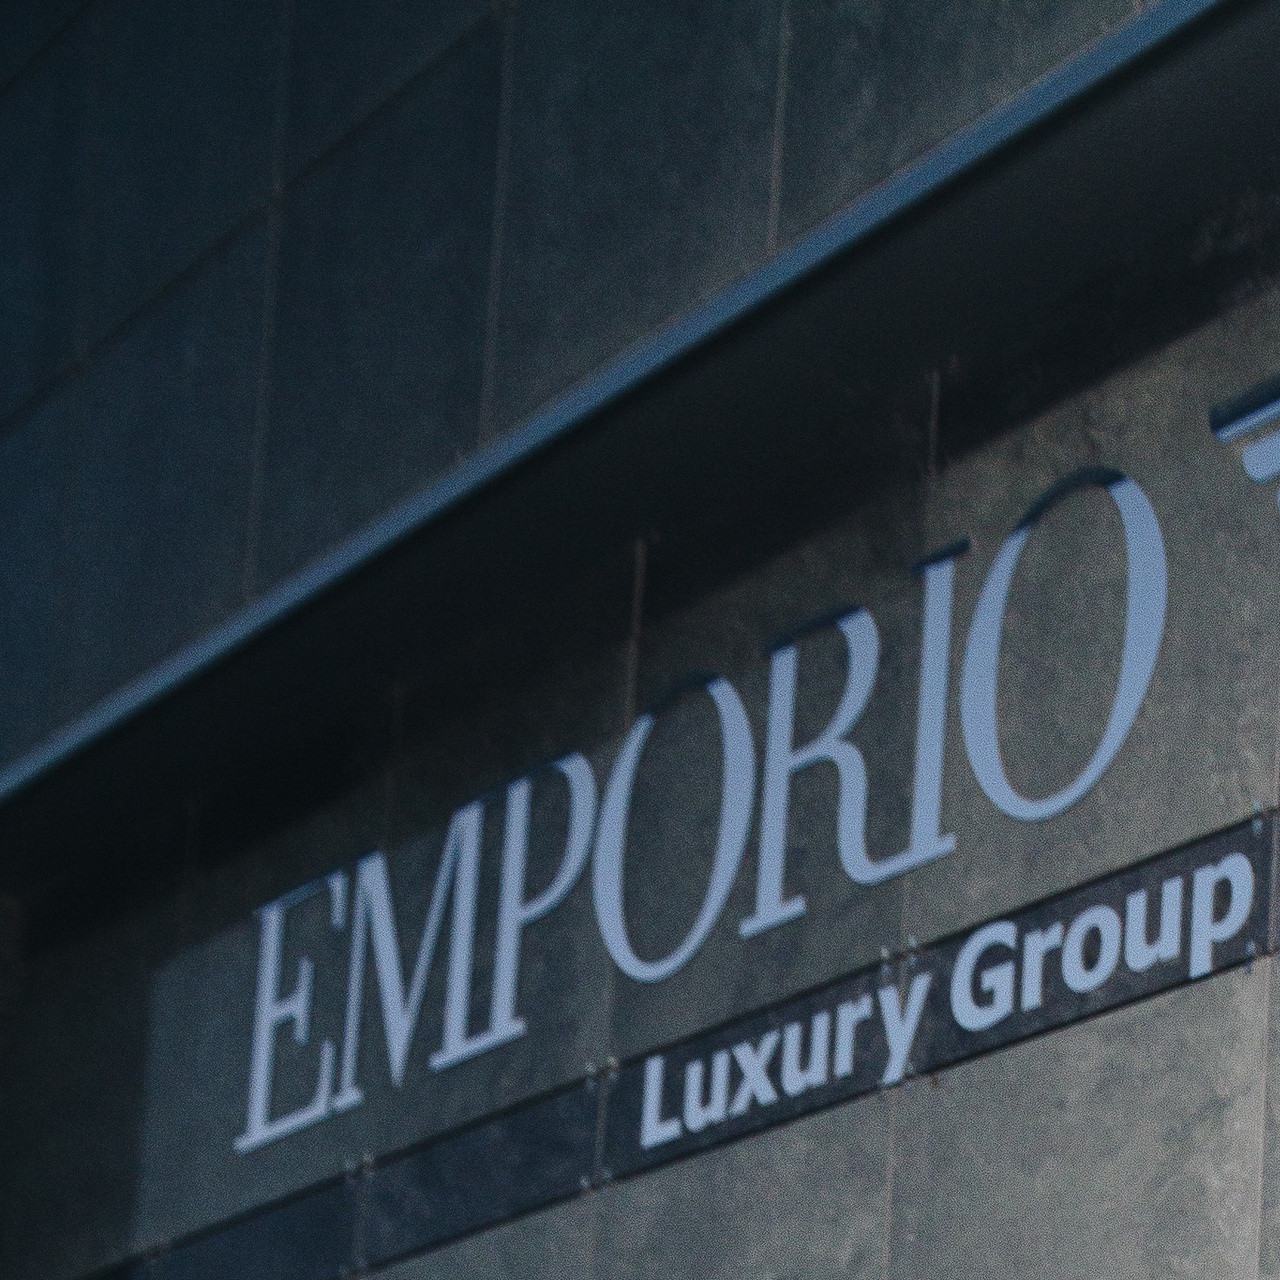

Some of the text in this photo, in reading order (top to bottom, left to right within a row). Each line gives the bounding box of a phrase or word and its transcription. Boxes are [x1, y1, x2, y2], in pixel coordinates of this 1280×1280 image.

[234, 466, 1168, 1154] EMPORIO
[640, 970, 929, 1148] Luxury
[950, 852, 1255, 1034] Group
